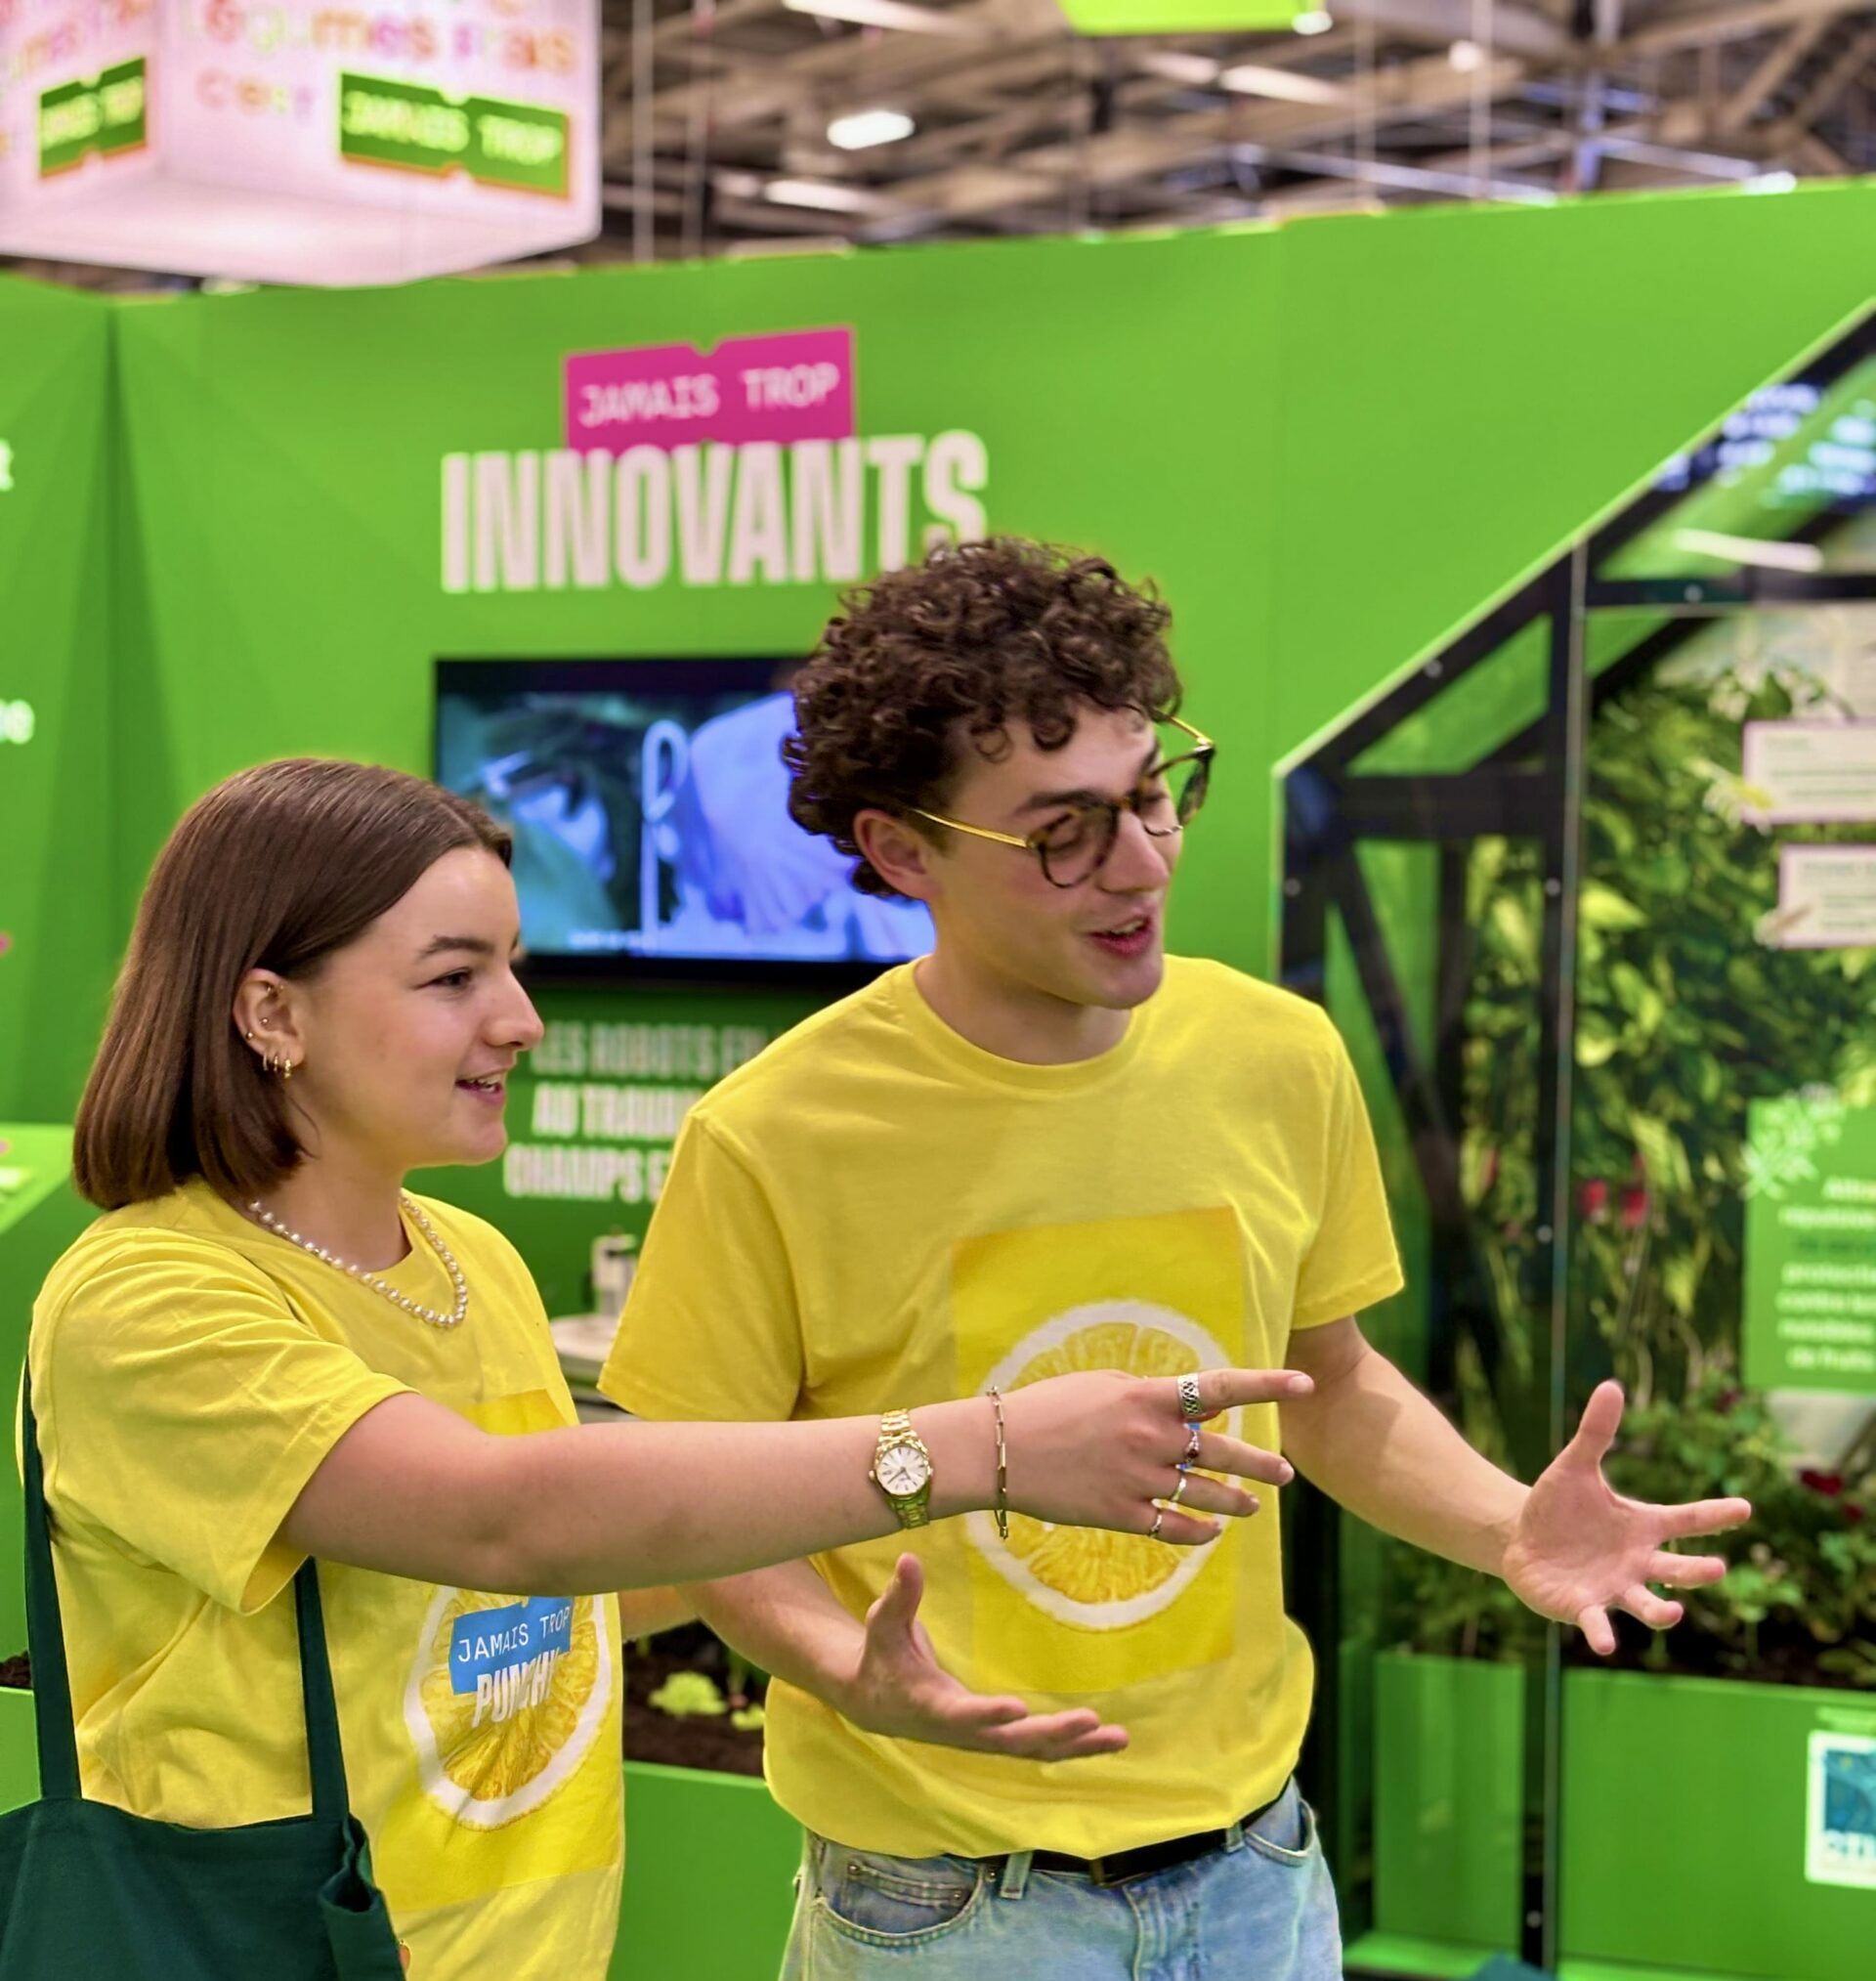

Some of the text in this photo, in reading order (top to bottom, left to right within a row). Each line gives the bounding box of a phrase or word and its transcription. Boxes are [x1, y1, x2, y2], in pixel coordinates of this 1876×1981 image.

[478, 114, 562, 165] TROP
[579, 362, 840, 427] JAMAIS TROP
[442, 430, 988, 593] INNOVANTS
[533, 1082, 579, 1138] AU
[504, 1143, 644, 1203] CHAMPS
[457, 1607, 570, 1662] JAMAIS TROP
